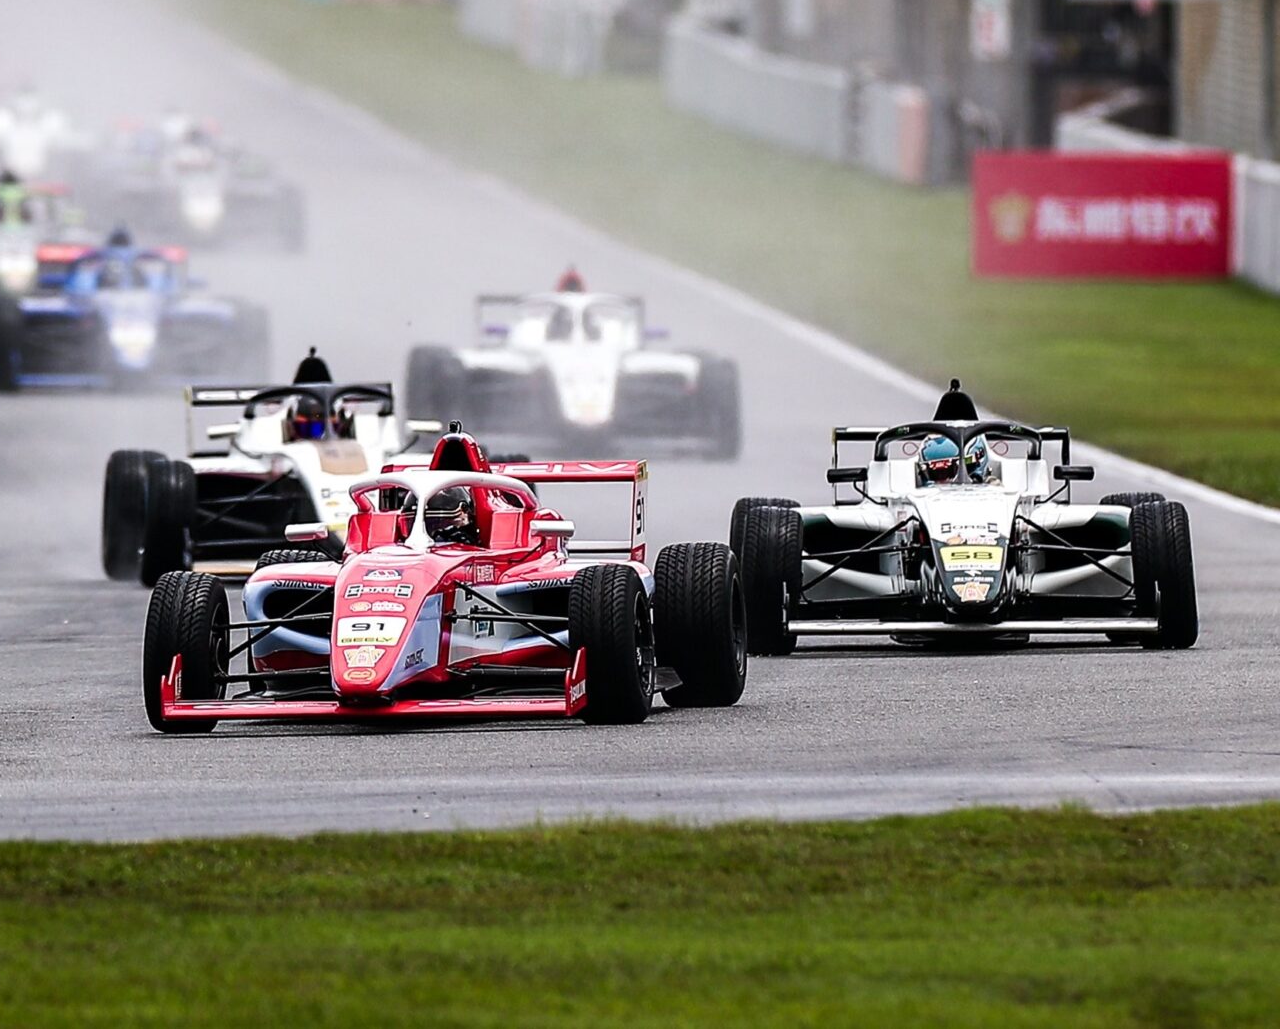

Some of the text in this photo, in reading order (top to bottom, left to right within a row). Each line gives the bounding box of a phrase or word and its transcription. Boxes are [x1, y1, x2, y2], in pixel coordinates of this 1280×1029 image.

[950, 551, 993, 560] 58
[351, 622, 385, 632] 91
[340, 636, 393, 644] GEELY
